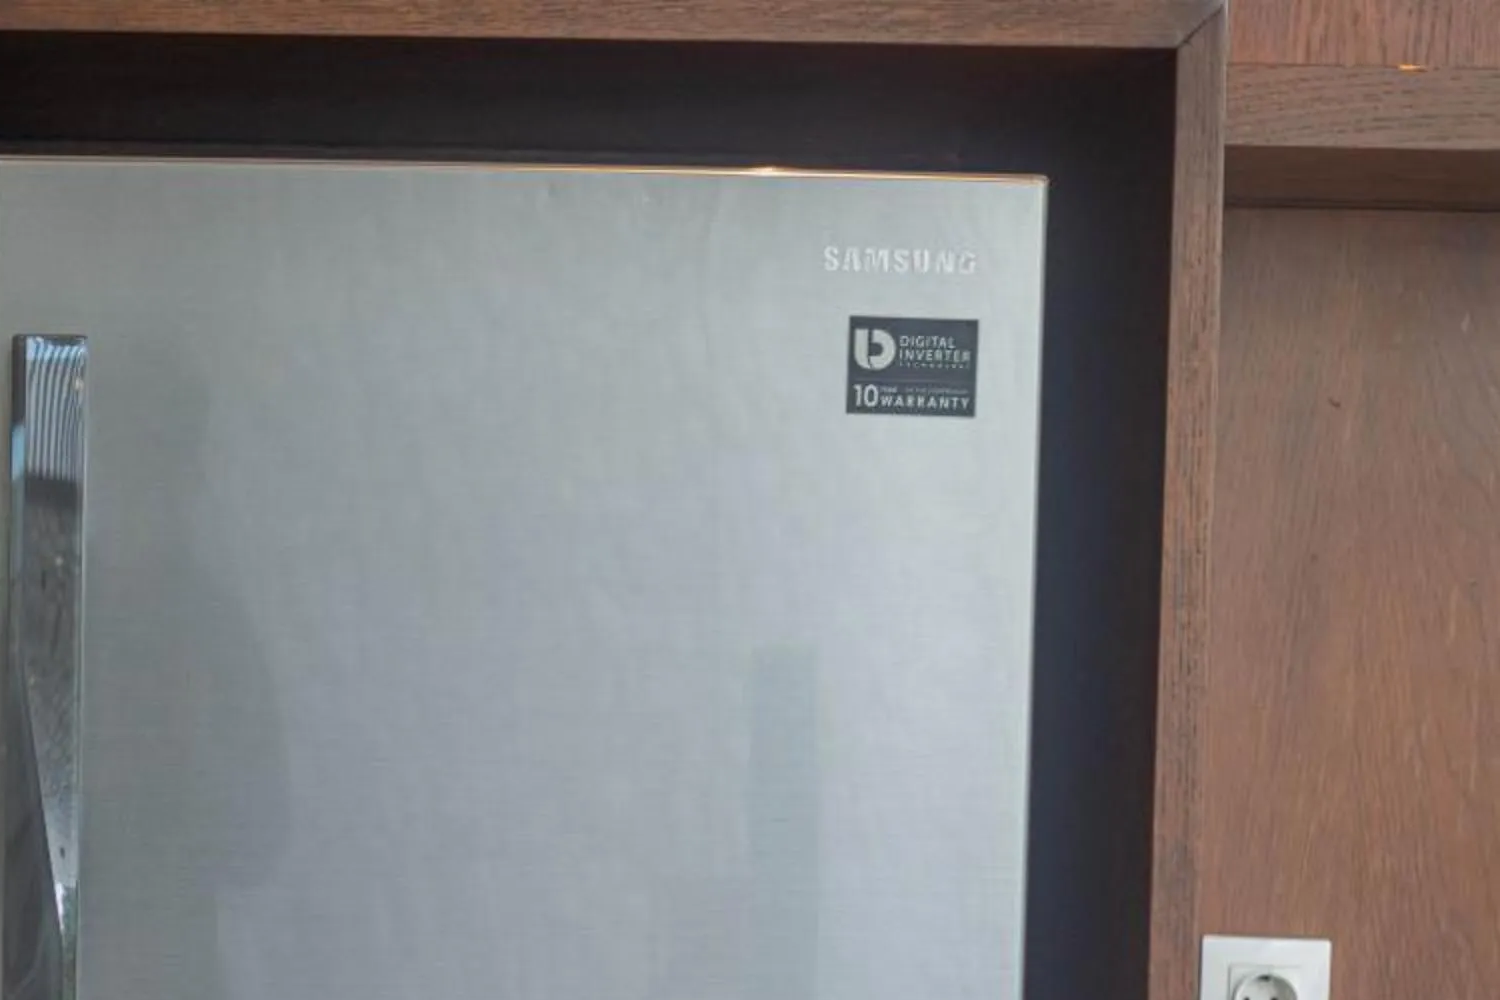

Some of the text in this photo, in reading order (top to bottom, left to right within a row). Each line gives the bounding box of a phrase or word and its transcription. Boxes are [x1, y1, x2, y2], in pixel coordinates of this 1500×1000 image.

[823, 246, 977, 275] SAMSUNG
[899, 335, 956, 349] DIGITAL
[899, 349, 971, 363] INVERTER
[853, 384, 879, 407] 10
[880, 395, 970, 410] WARRANTY
